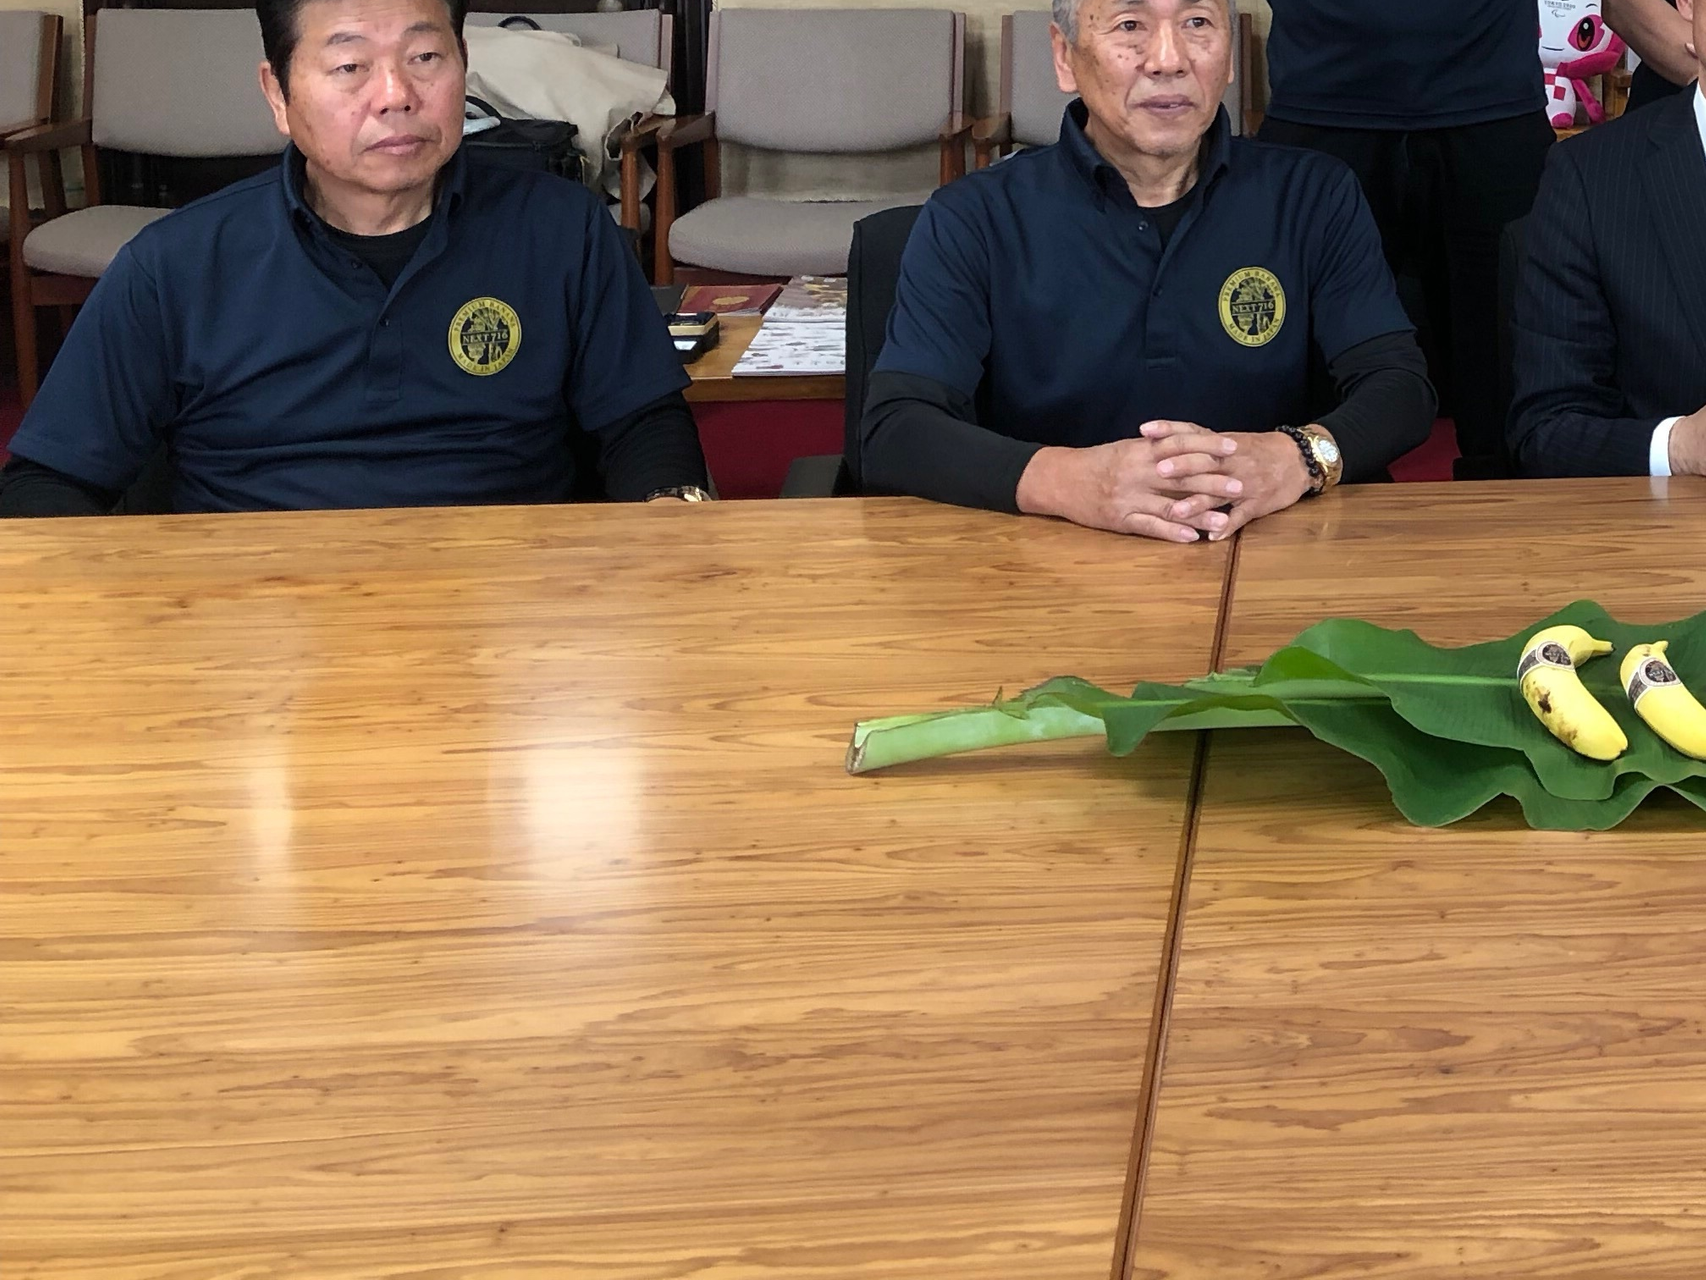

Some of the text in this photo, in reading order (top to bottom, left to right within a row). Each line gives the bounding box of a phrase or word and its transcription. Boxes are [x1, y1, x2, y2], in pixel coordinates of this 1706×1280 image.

[1223, 270, 1281, 301] PREMIUM BANANA
[454, 301, 516, 331] PREMIUM BANANA
[1232, 301, 1275, 313] NEXT 716
[463, 331, 509, 343] NEXT 716
